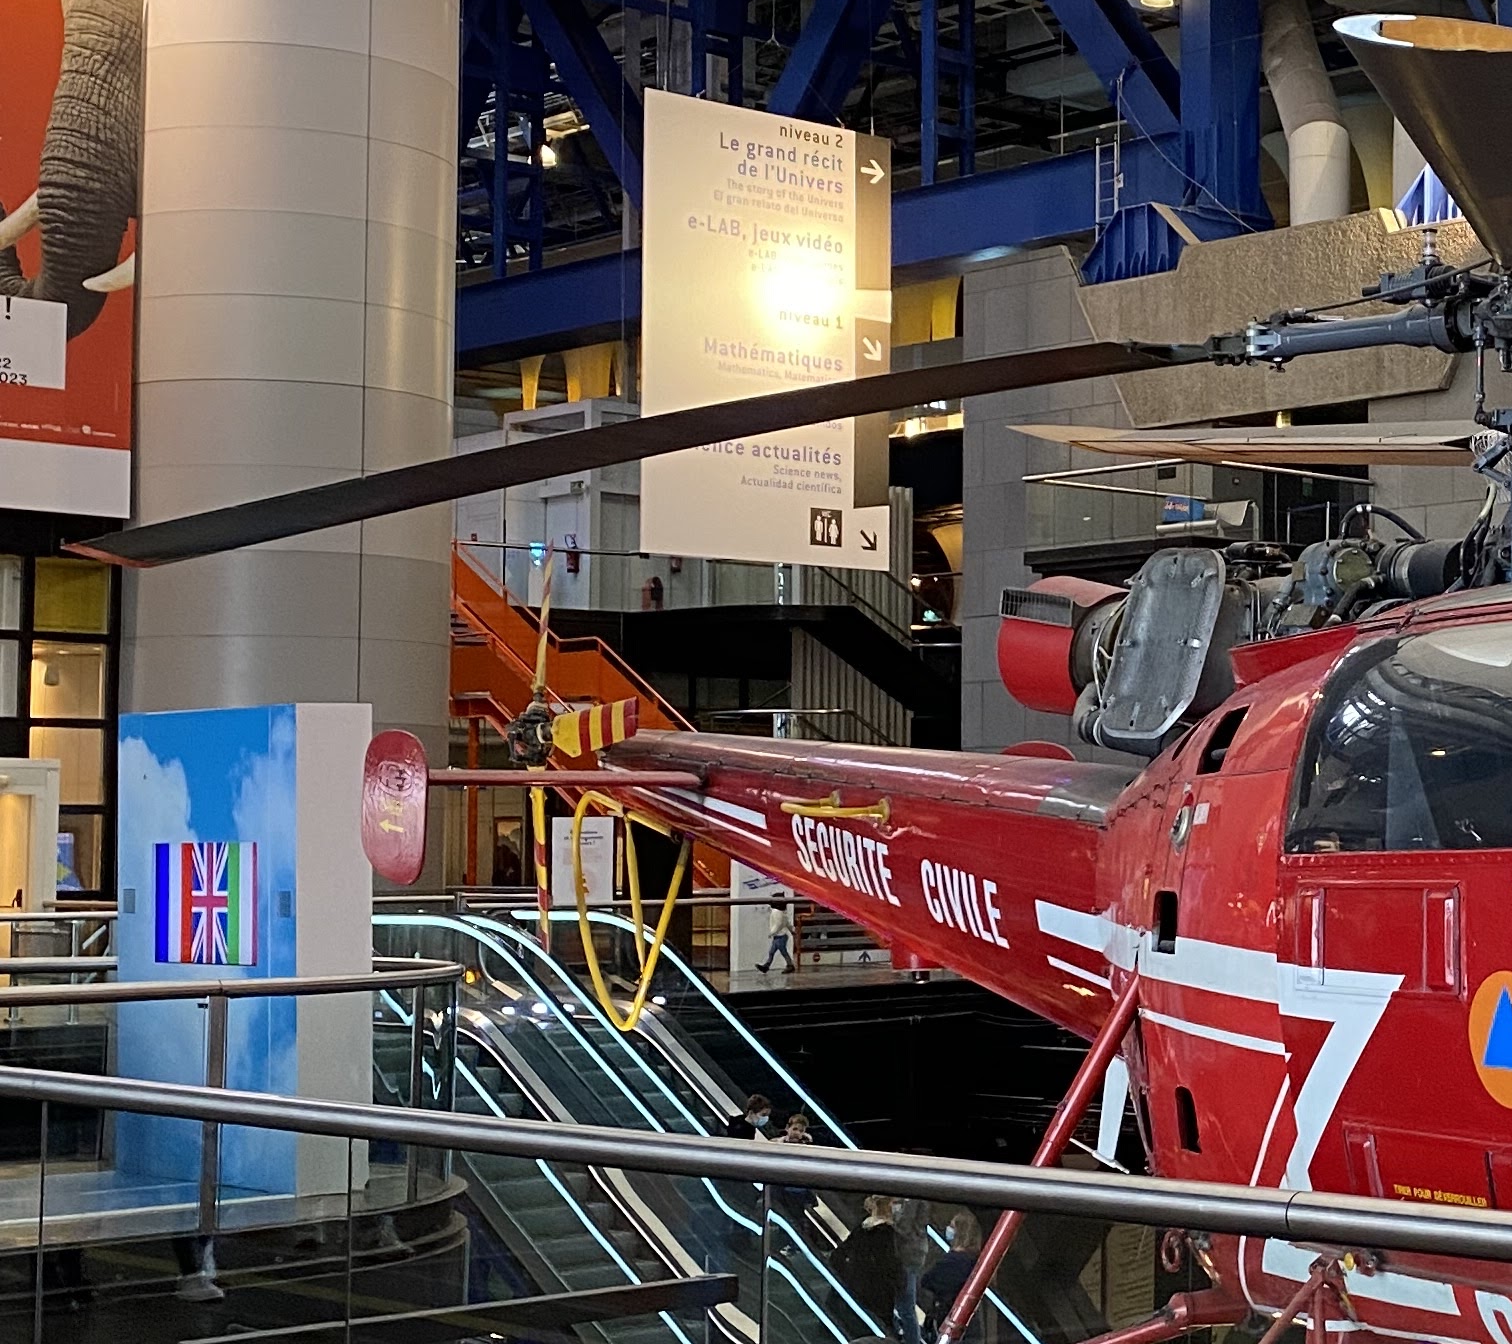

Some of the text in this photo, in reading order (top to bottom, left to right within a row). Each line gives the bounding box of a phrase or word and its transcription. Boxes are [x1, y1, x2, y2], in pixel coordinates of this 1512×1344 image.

[779, 124, 843, 148] niveau 2
[719, 131, 843, 172] Le grand récit
[737, 159, 843, 194] de l'Univers
[726, 177, 744, 192] The
[746, 182, 773, 199] story
[775, 188, 787, 200] of
[788, 190, 805, 203] the
[726, 193, 749, 207] gran
[751, 196, 781, 212] relato
[784, 202, 800, 216] del
[802, 206, 844, 223] Universo
[687, 215, 844, 254] e-LAB, jeux vidéo
[779, 309, 844, 329] niveau 1
[704, 336, 844, 373] Mathématiques
[0, 372, 27, 386] 023
[751, 444, 842, 466] actualités
[740, 475, 842, 495] Actualidad científica
[773, 464, 842, 482] Science news,
[791, 813, 1010, 949] SECURITE CIVILE
[1413, 1187, 1432, 1199] POUR
